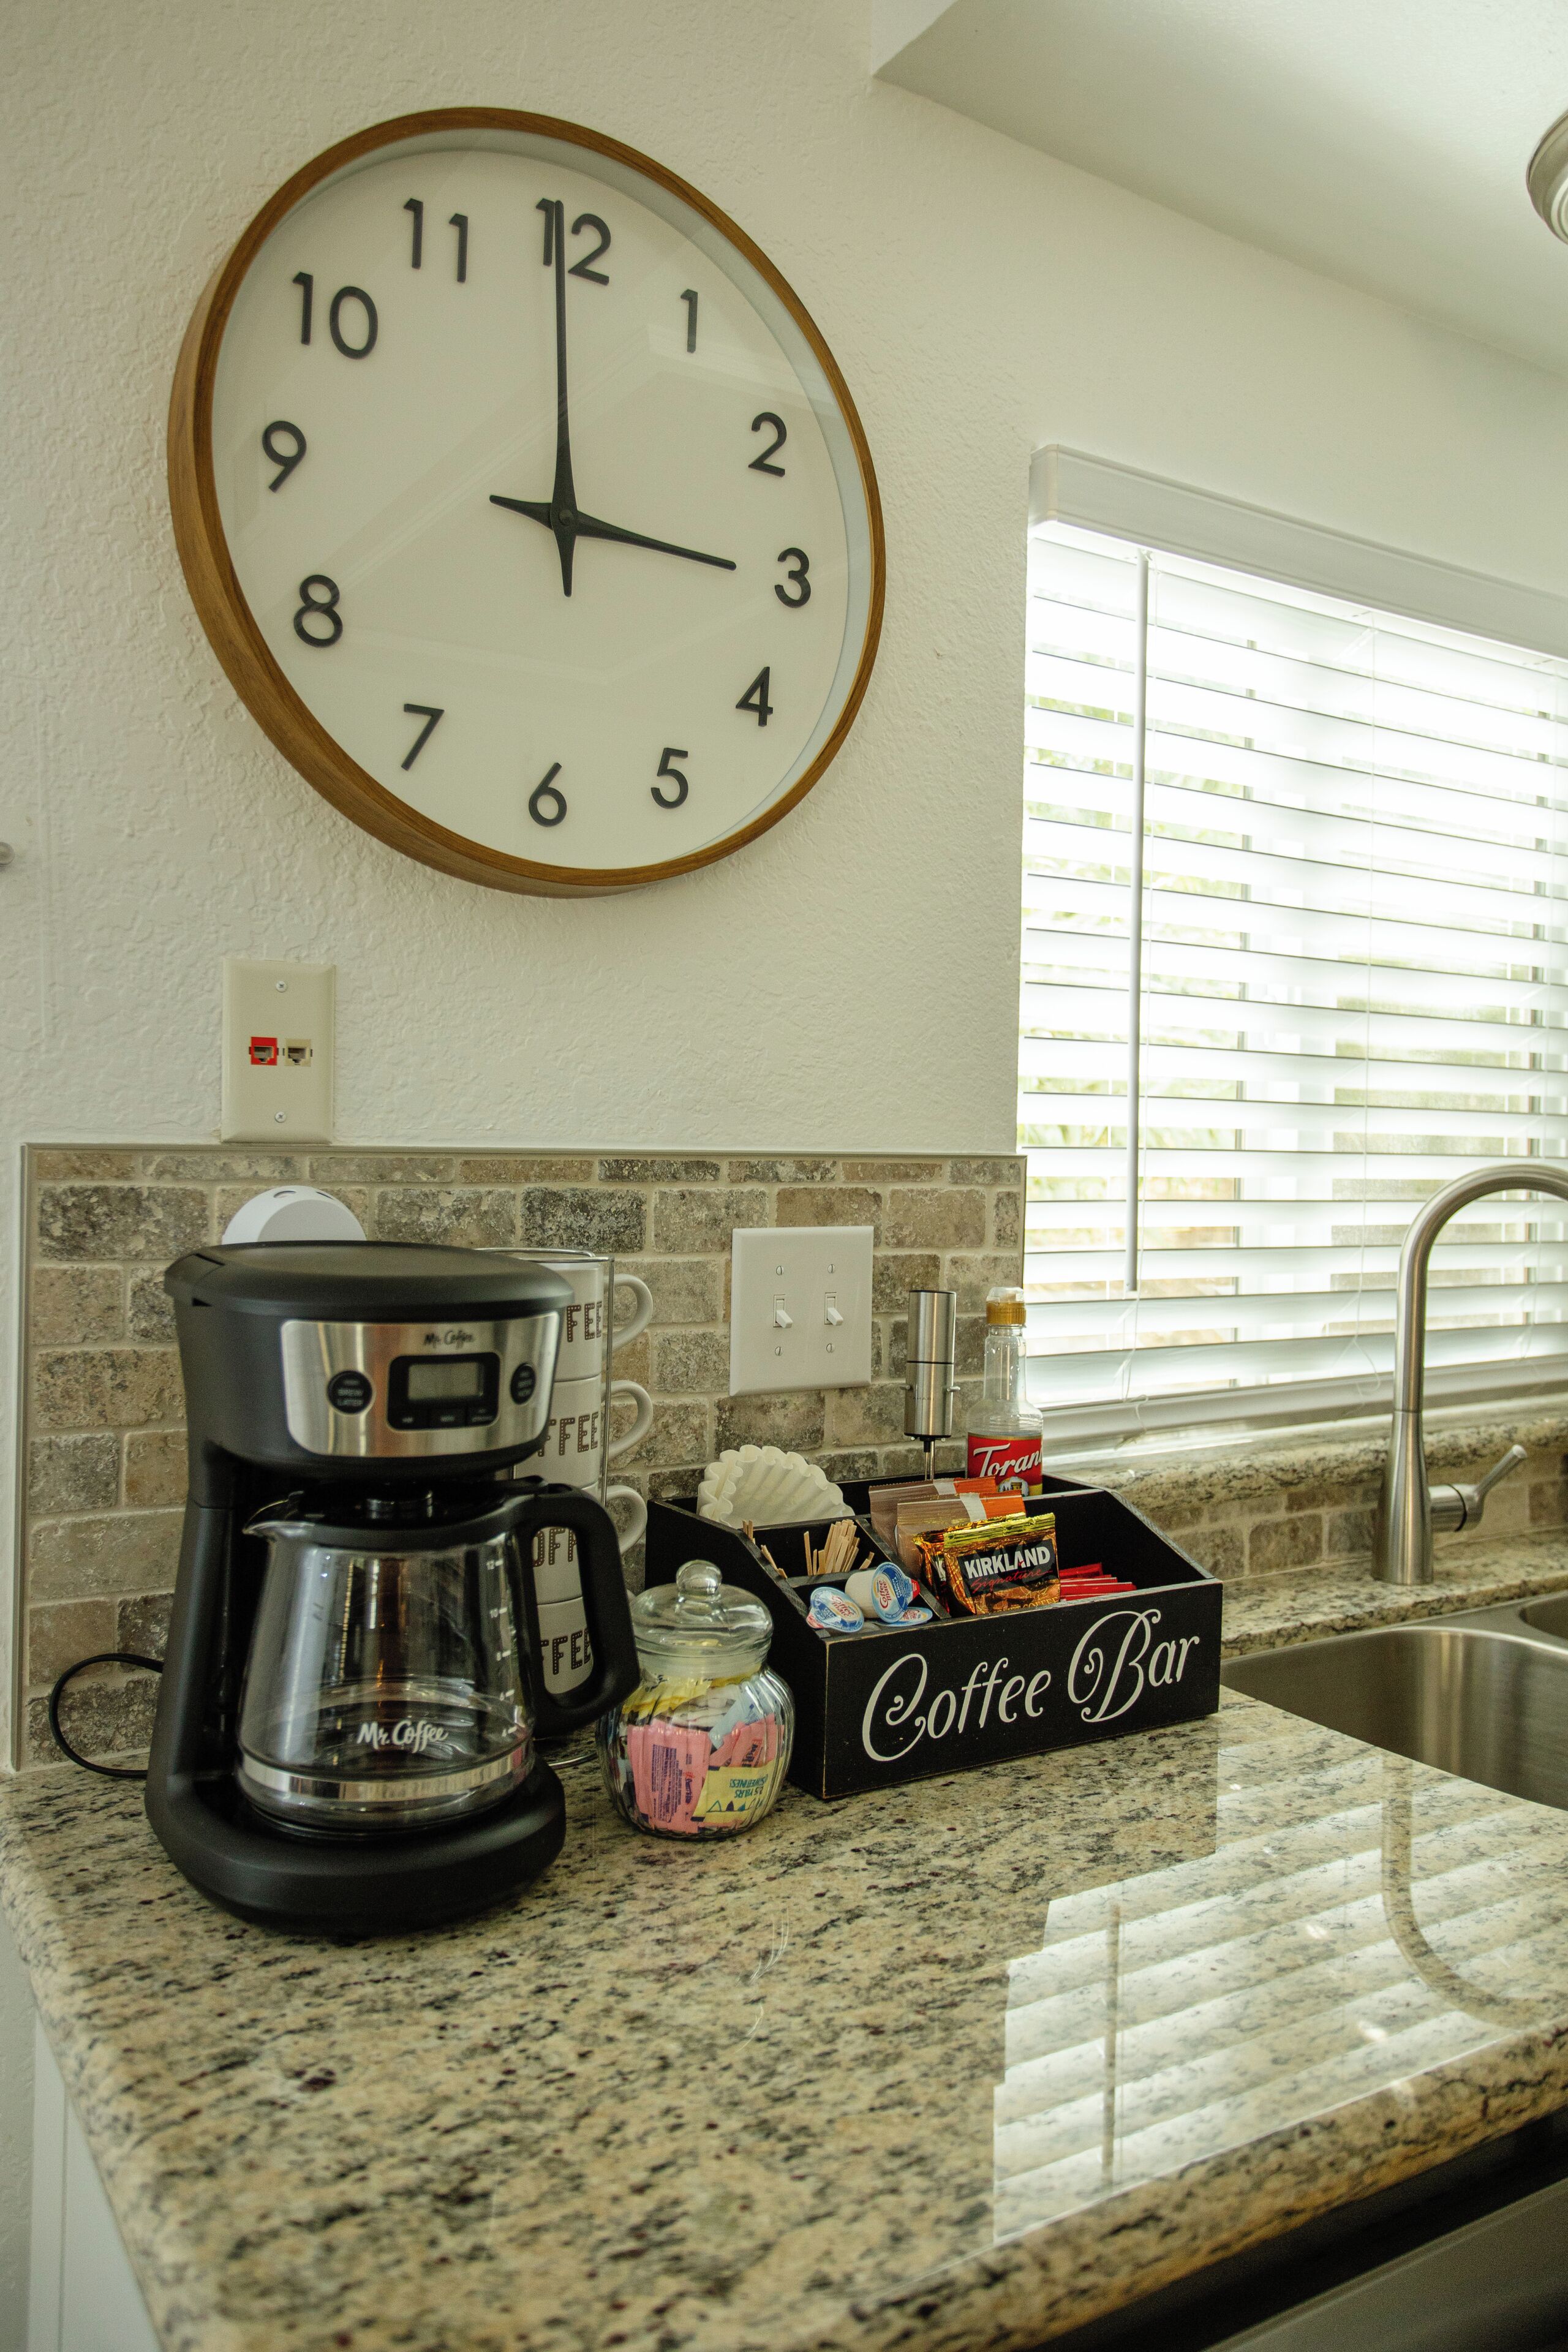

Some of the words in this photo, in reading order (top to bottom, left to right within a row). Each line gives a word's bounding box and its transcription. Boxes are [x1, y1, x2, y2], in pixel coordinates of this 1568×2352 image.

[403, 198, 469, 283] 11
[535, 198, 611, 285] 12
[292, 271, 379, 360] 10
[680, 288, 699, 353] 1
[262, 420, 307, 492] 9
[748, 412, 787, 477] 2
[774, 547, 812, 609] 3
[293, 574, 343, 648] 8
[735, 666, 774, 727] 4
[401, 703, 445, 771] 7
[528, 762, 567, 827] 6
[650, 747, 689, 809] 5
[443, 1330, 475, 1349] Coffee
[879, 1580, 889, 1608] Coffee
[883, 1581, 892, 1601] mate
[963, 1545, 1051, 1580] KIRKLAND
[971, 1569, 1053, 1594] Signature
[541, 1627, 592, 1675] FEE
[862, 1653, 1051, 1762] Coffee
[1067, 1608, 1200, 1723] Bar
[356, 1721, 390, 1750] Mr.
[392, 1719, 449, 1753] Coffee
